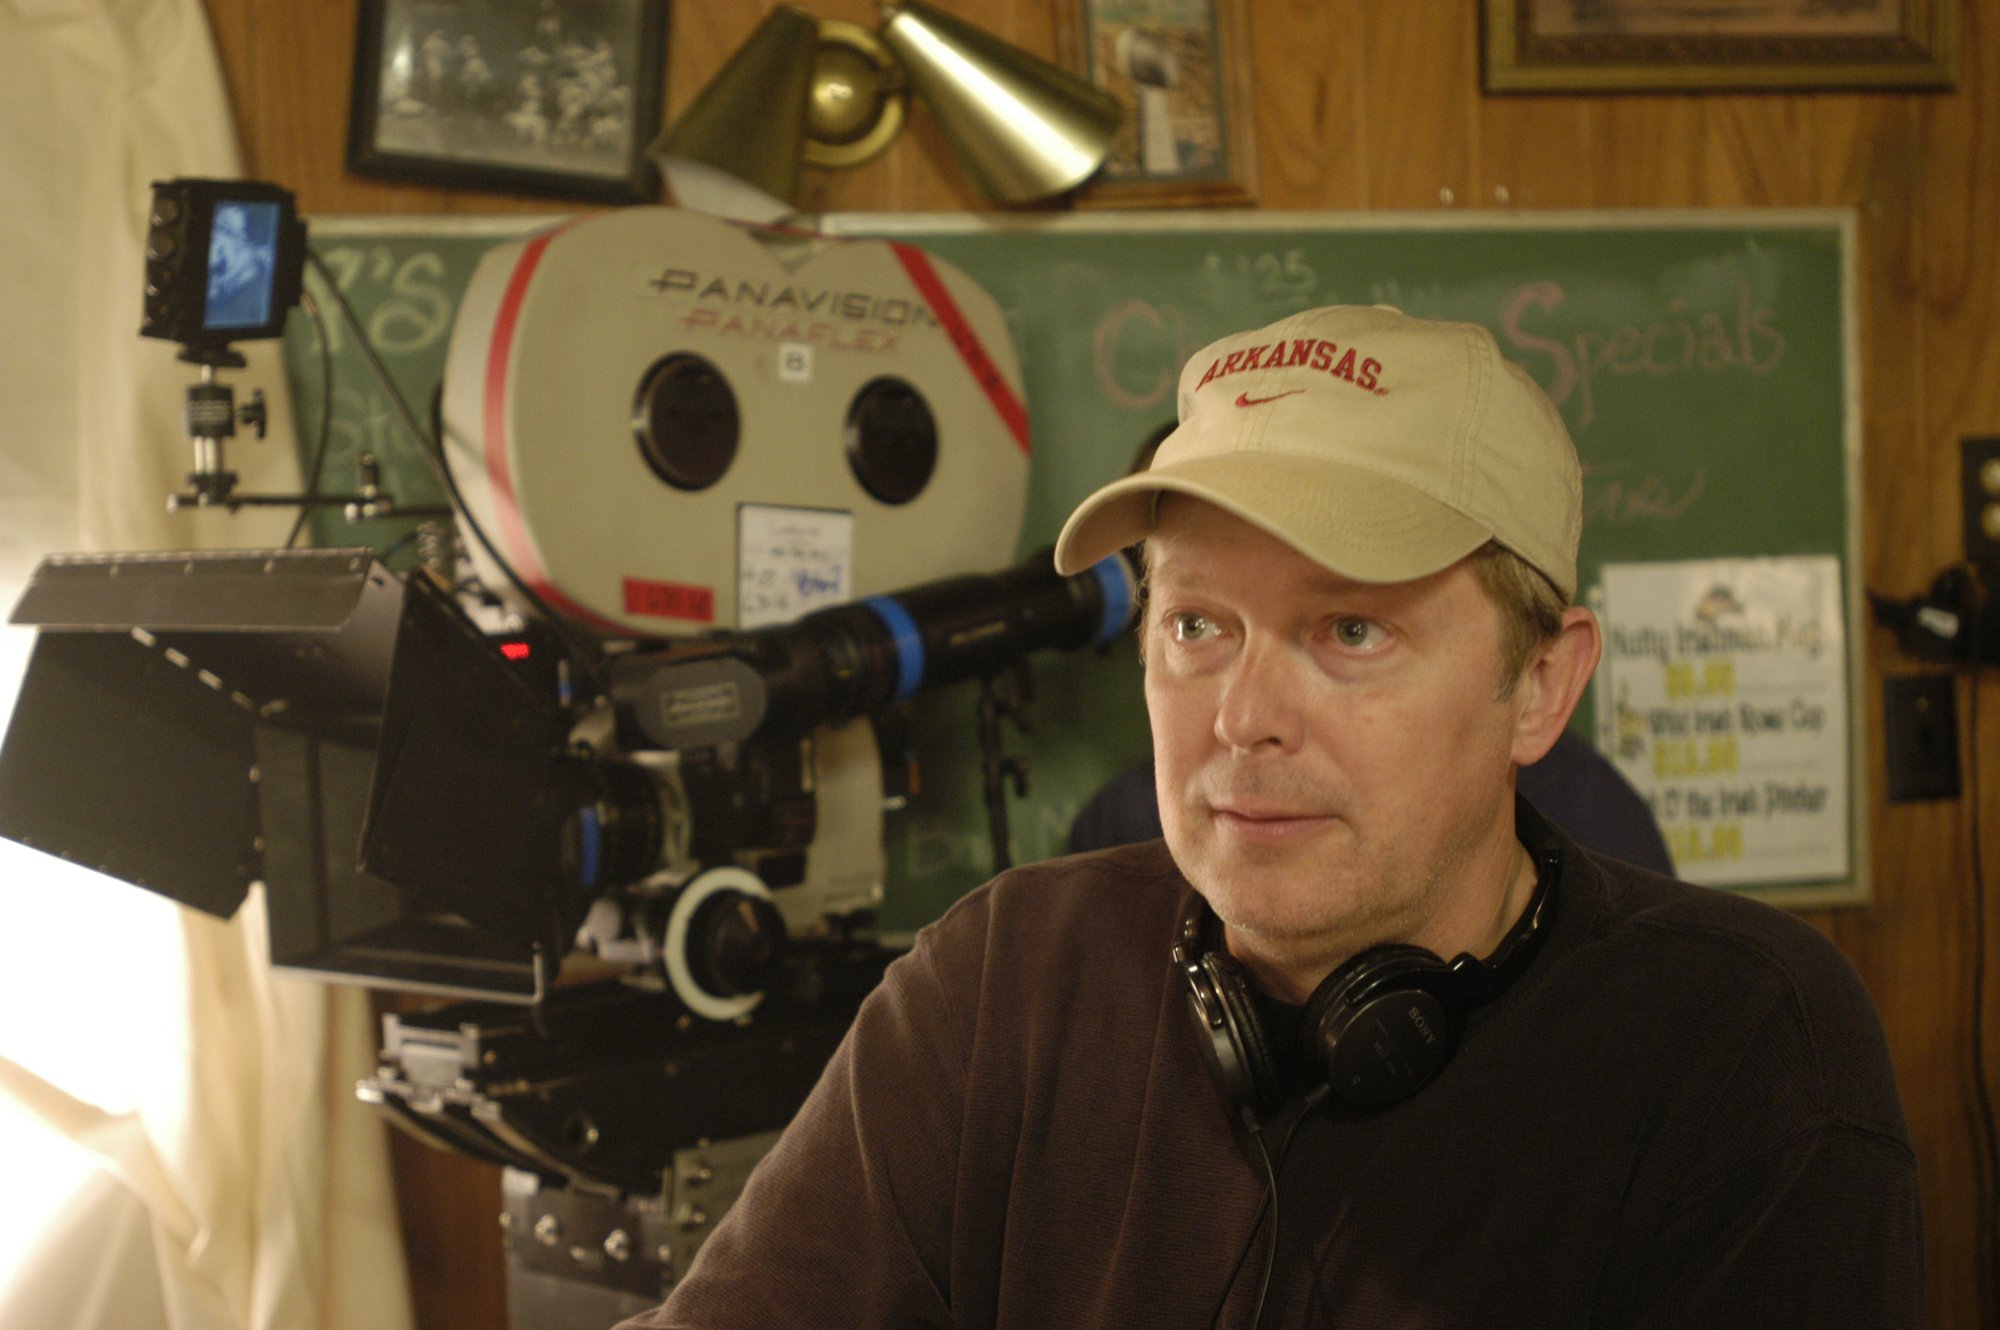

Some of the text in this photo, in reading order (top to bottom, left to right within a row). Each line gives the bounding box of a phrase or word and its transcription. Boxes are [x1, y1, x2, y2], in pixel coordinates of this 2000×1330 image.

[648, 268, 938, 328] PANAVISION
[678, 307, 898, 352] PANAFLEX
[1503, 281, 1786, 428] Specials
[1195, 338, 1384, 393] ARKANSAS
[1408, 1006, 1436, 1044] SONY
